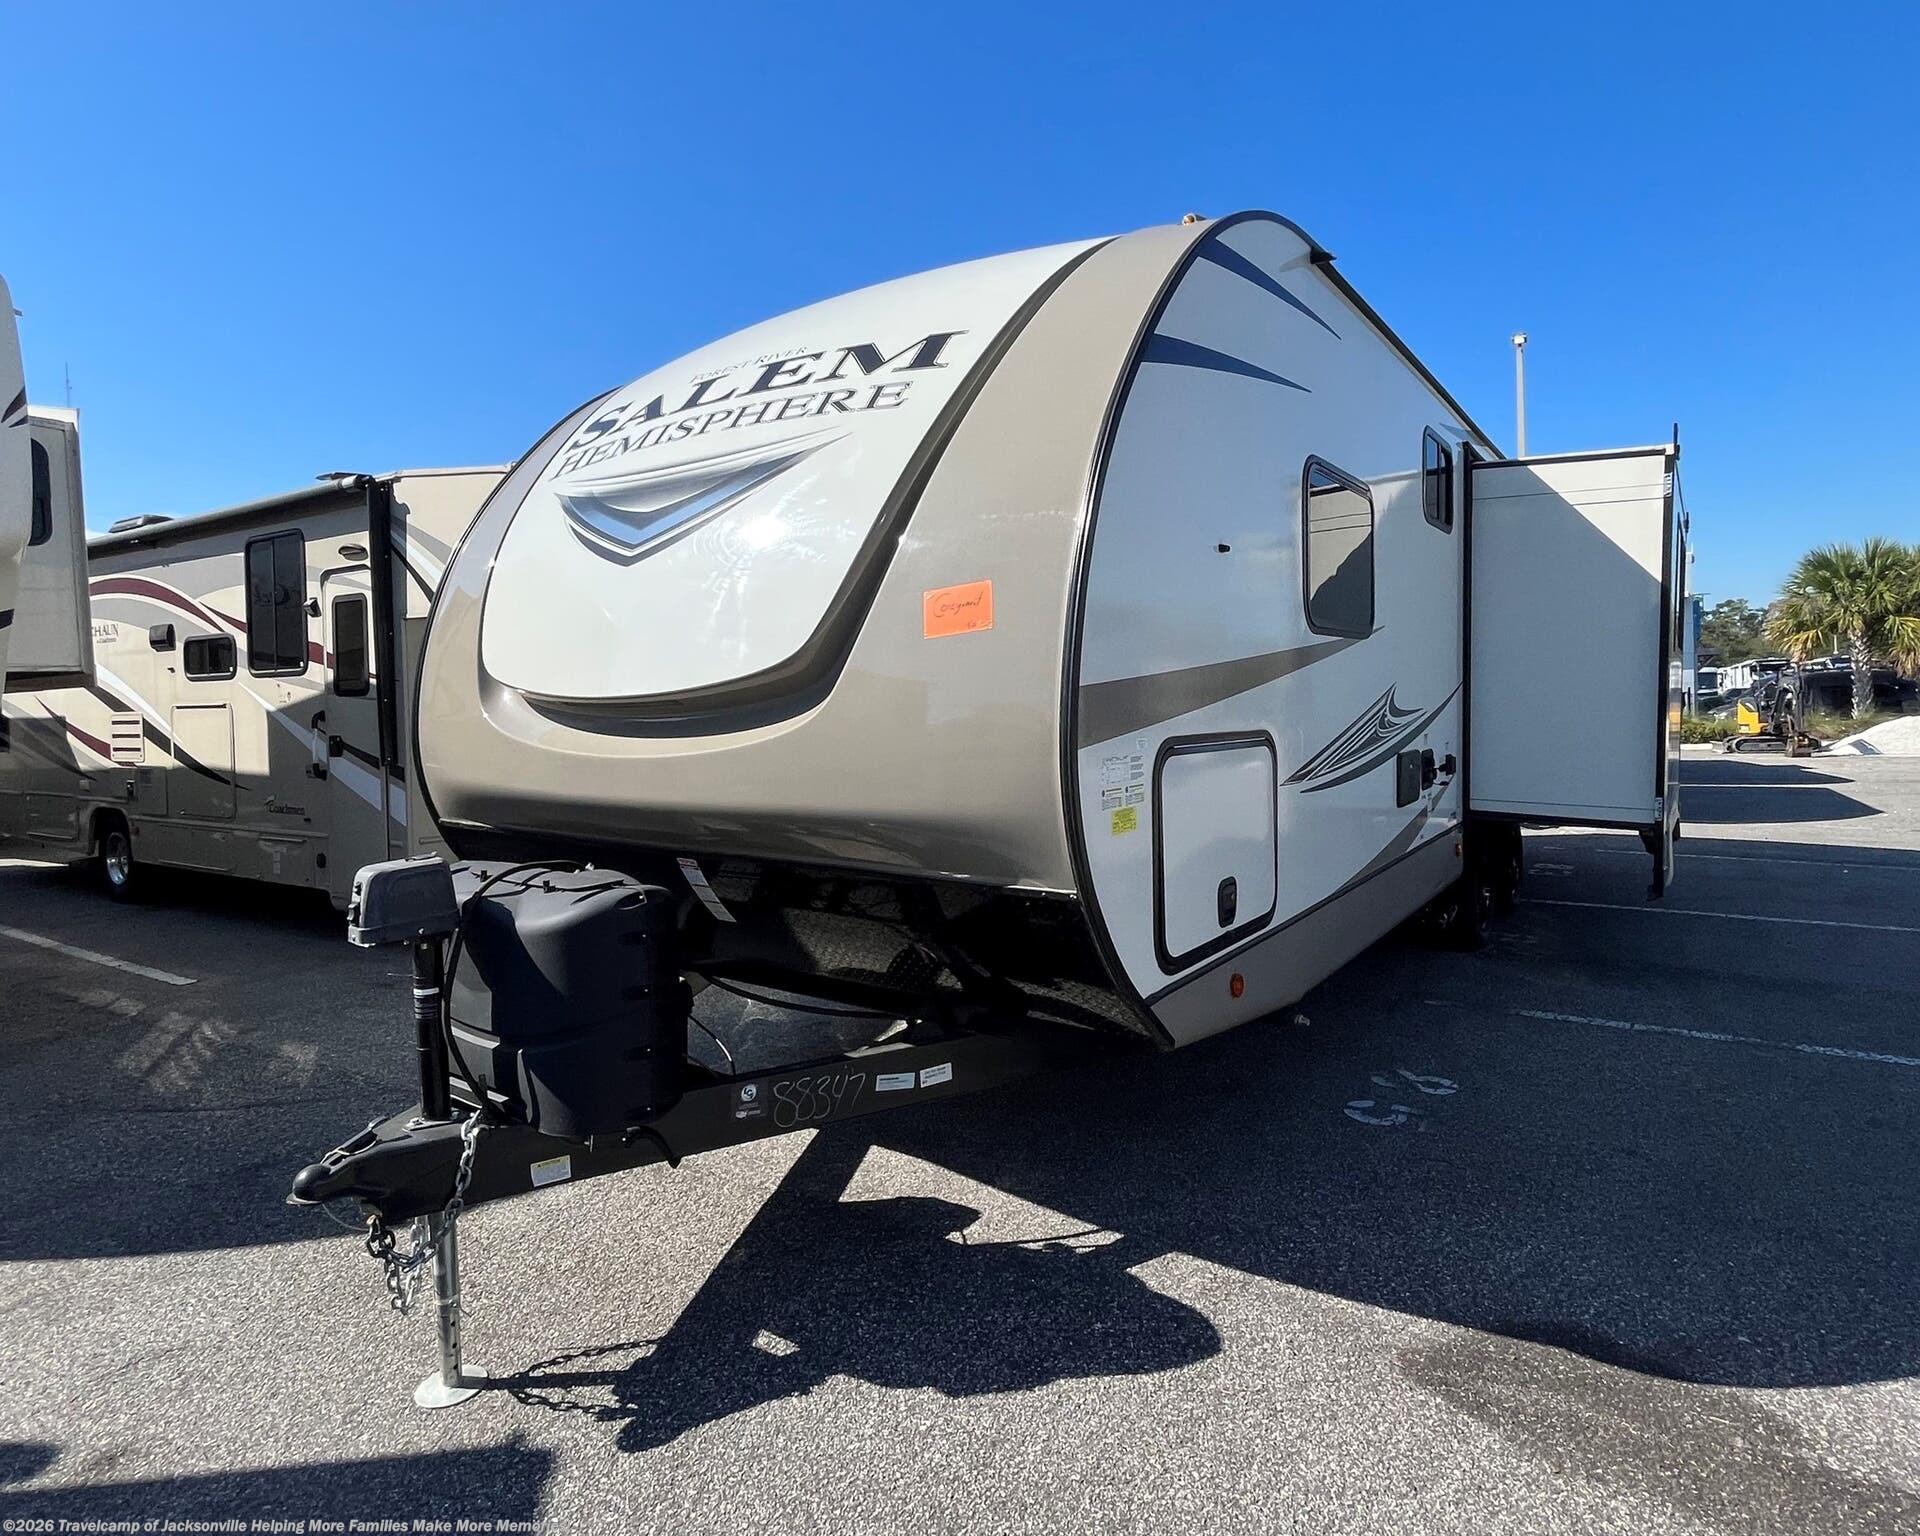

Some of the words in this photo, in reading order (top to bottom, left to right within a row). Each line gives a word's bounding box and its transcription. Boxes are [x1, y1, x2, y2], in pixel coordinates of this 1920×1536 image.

[563, 330, 970, 454] SALEM
[755, 347, 807, 365] RIVER
[550, 381, 914, 481] HEMISPHERE
[773, 1072, 866, 1128] 88347
